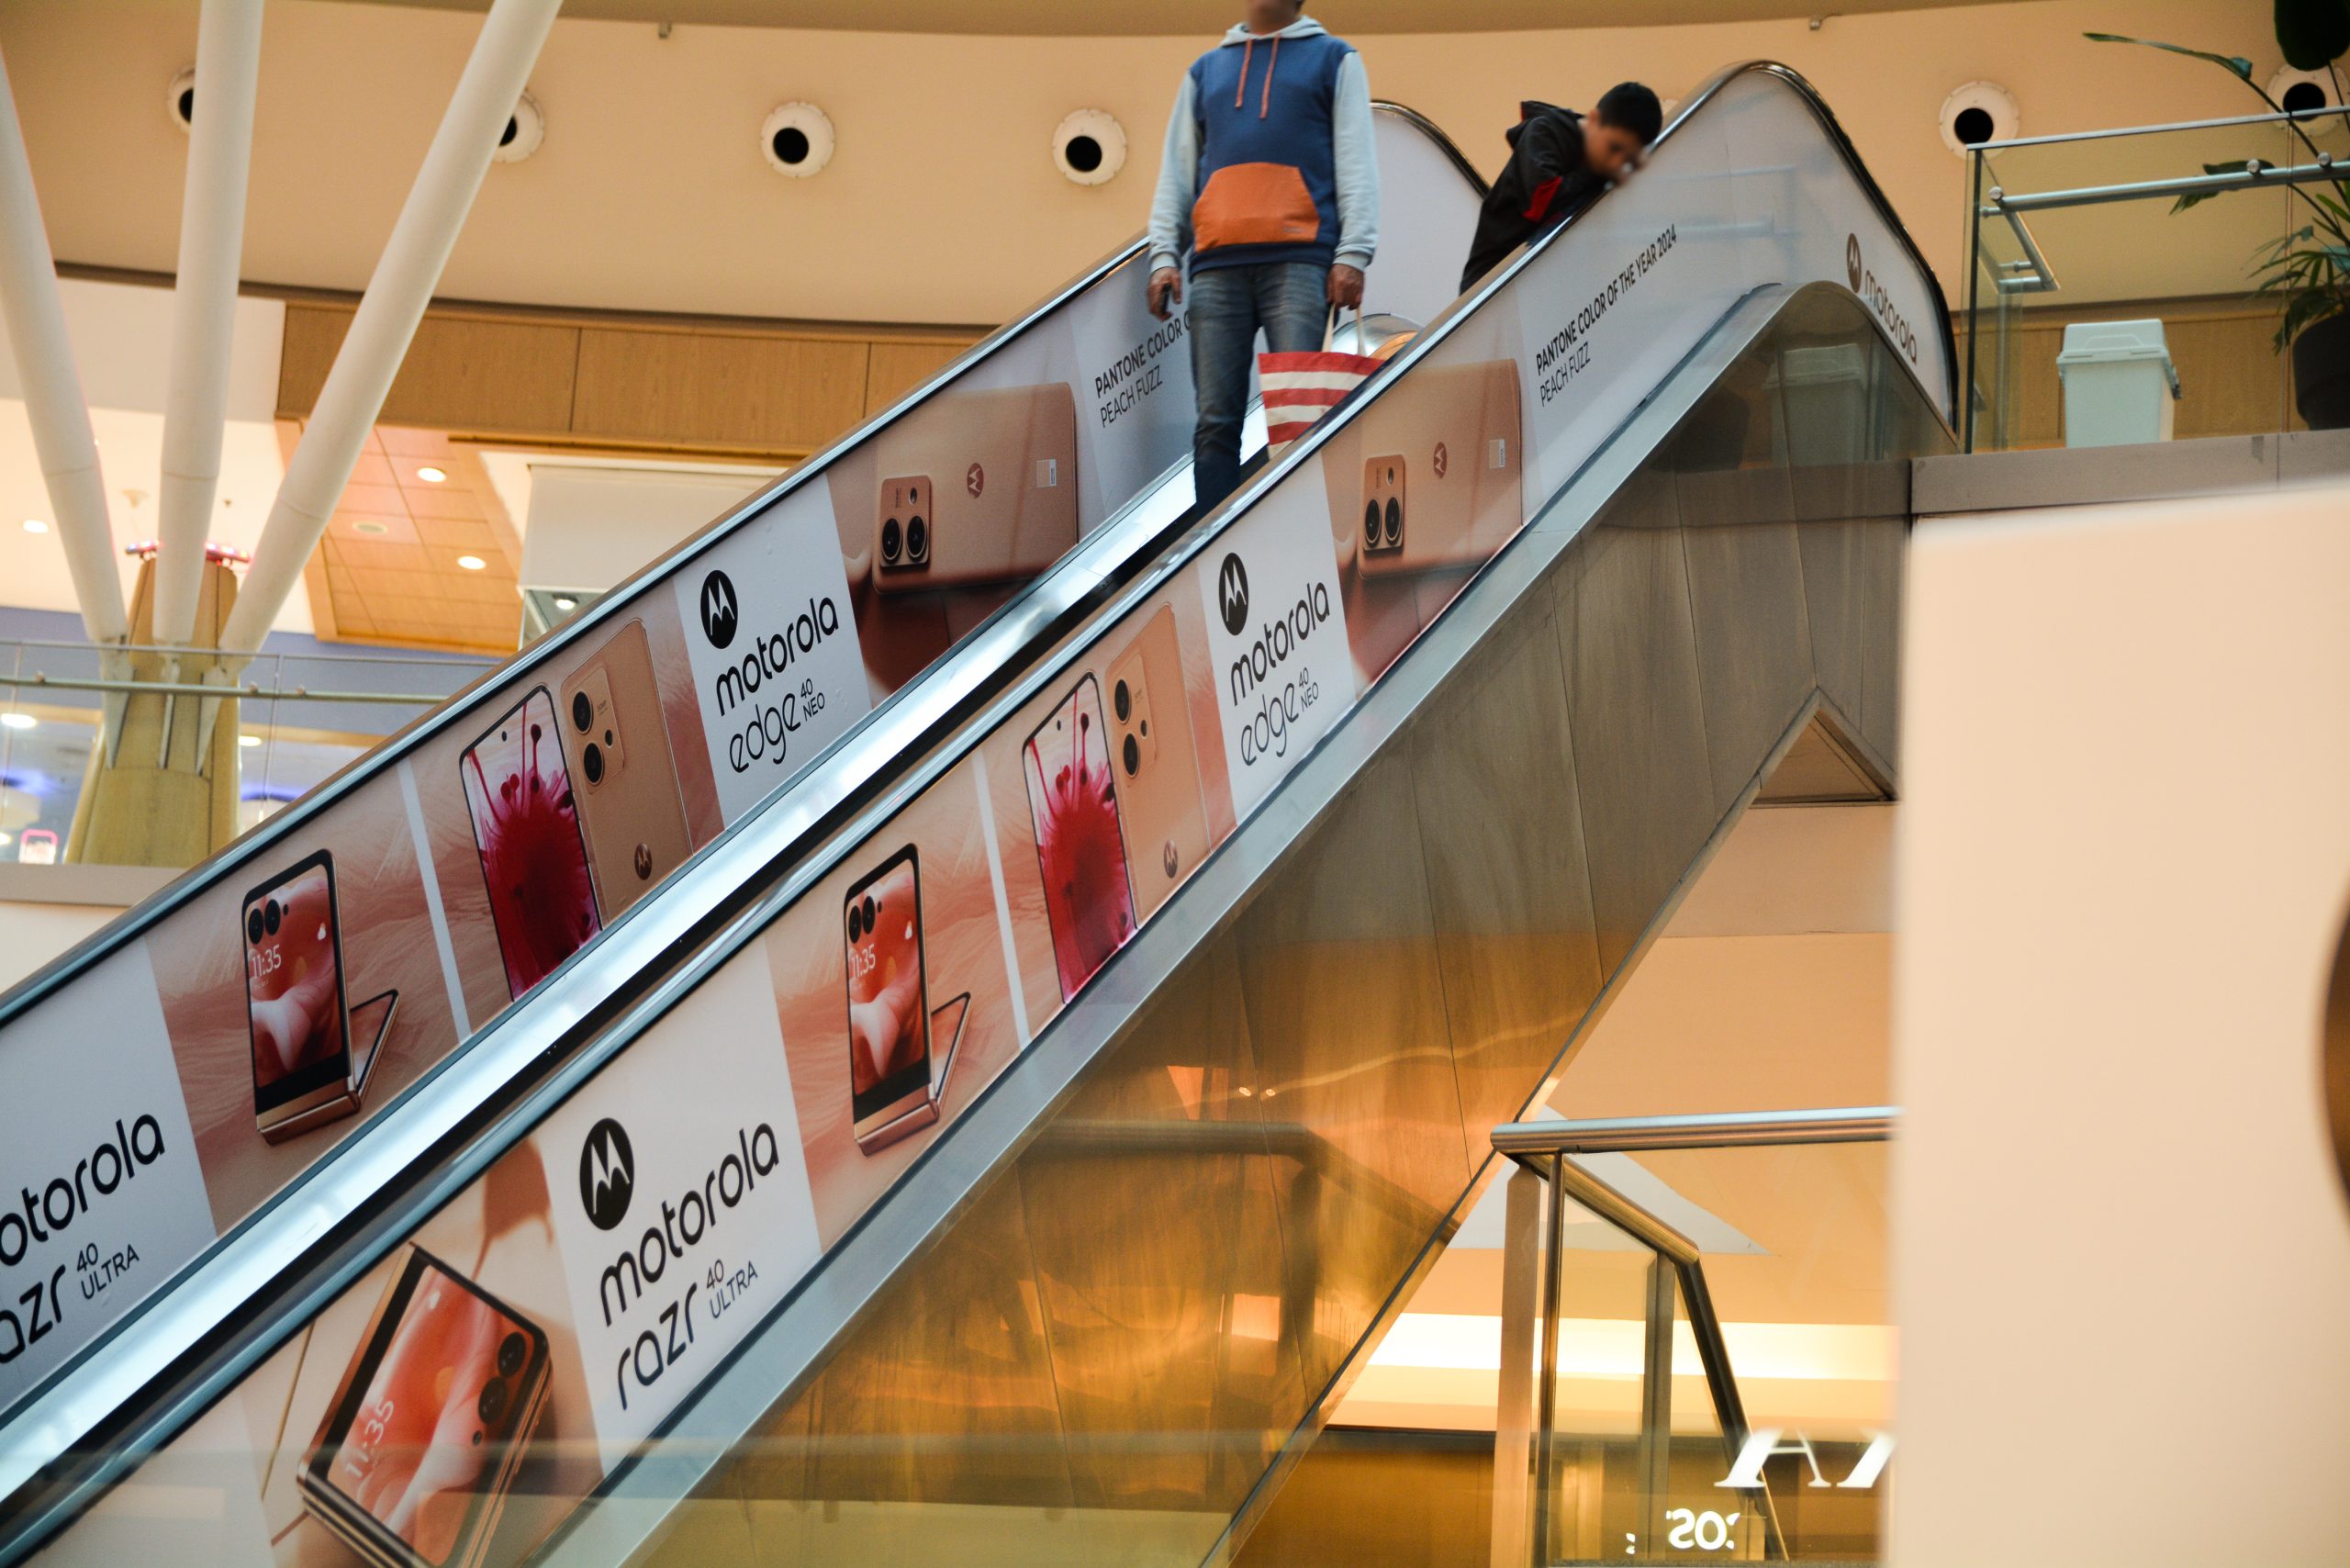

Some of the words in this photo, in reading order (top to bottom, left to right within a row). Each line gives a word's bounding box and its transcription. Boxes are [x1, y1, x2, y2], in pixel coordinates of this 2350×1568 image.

[1536, 319, 1578, 376] PANTONE
[1578, 292, 1606, 335] COLOR
[1607, 279, 1618, 306] OF
[1618, 263, 1636, 294] THE
[1635, 244, 1657, 277] YEAR
[1657, 223, 1677, 257] 2024
[1864, 269, 1918, 366] motorola
[1095, 344, 1147, 398] PANTONE
[1147, 318, 1182, 358] COLOR
[1539, 363, 1569, 407] PEACH
[1569, 342, 1591, 379] FUZZ
[1100, 385, 1136, 428] PEACH
[1136, 364, 1163, 401] FUZZ
[716, 598, 839, 717] motorola
[1230, 582, 1330, 707] motorola
[800, 678, 813, 699] 40
[802, 692, 825, 722] NEO
[1298, 666, 1309, 689] 40
[1301, 682, 1319, 712] NEO
[729, 693, 801, 773] edge
[1241, 682, 1299, 766] edge
[251, 944, 282, 980] 11:35
[851, 944, 876, 980] 11:35
[0, 1114, 165, 1266] otorola
[76, 1242, 98, 1272] 40
[599, 1123, 780, 1327] motorola
[80, 1244, 140, 1300] ULTRA
[706, 1259, 724, 1290] 40
[710, 1260, 758, 1319] ULTRA
[0, 1264, 66, 1363] azr
[617, 1282, 698, 1411] razr
